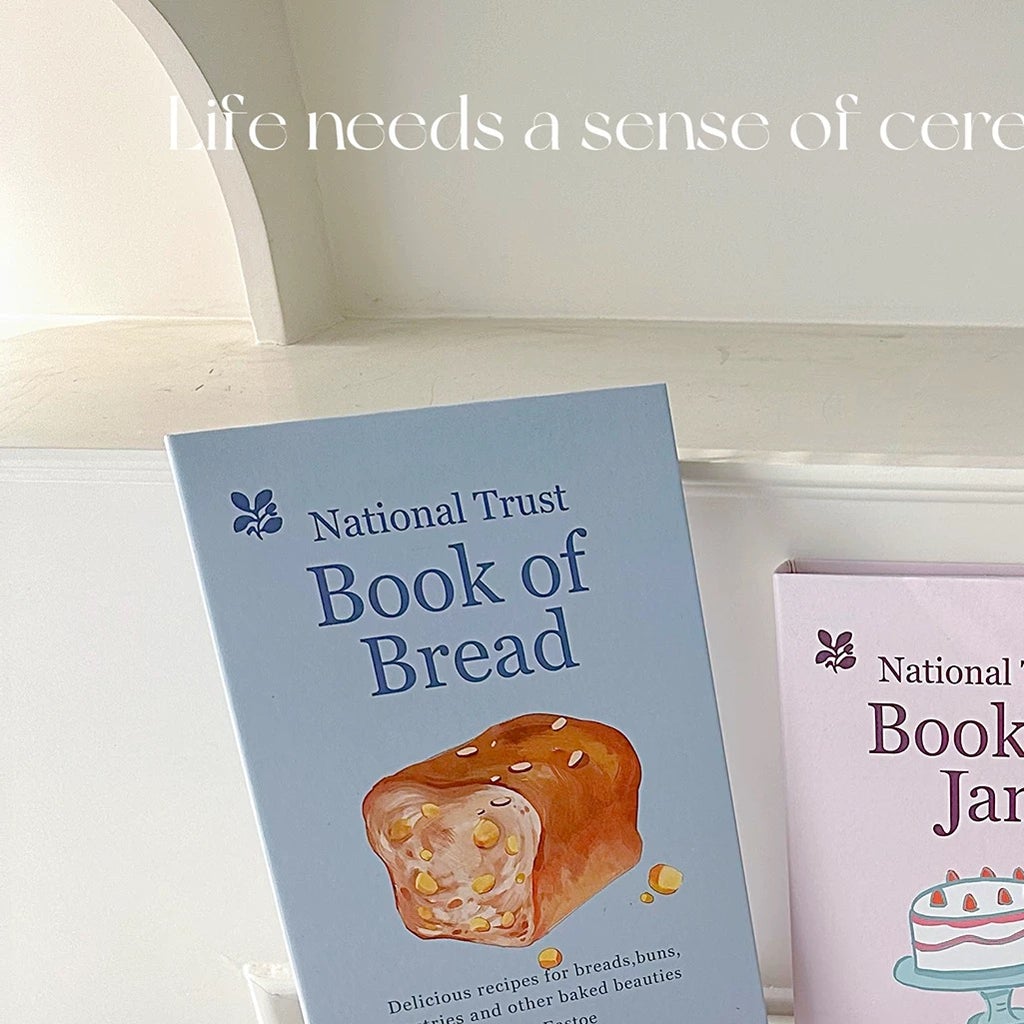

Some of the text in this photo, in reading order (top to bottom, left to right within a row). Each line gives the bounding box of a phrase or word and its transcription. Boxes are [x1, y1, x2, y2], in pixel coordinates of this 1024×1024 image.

[308, 485, 570, 542] National Trust
[306, 527, 590, 628] Book of
[360, 606, 581, 696] Bread
[877, 656, 1012, 686] National
[387, 988, 472, 1015] Delicious
[477, 974, 540, 998] recipes
[544, 967, 569, 983] for
[470, 1003, 502, 1023] and
[508, 994, 554, 1015] other
[558, 981, 608, 1004] baked
[613, 967, 683, 992] beauties
